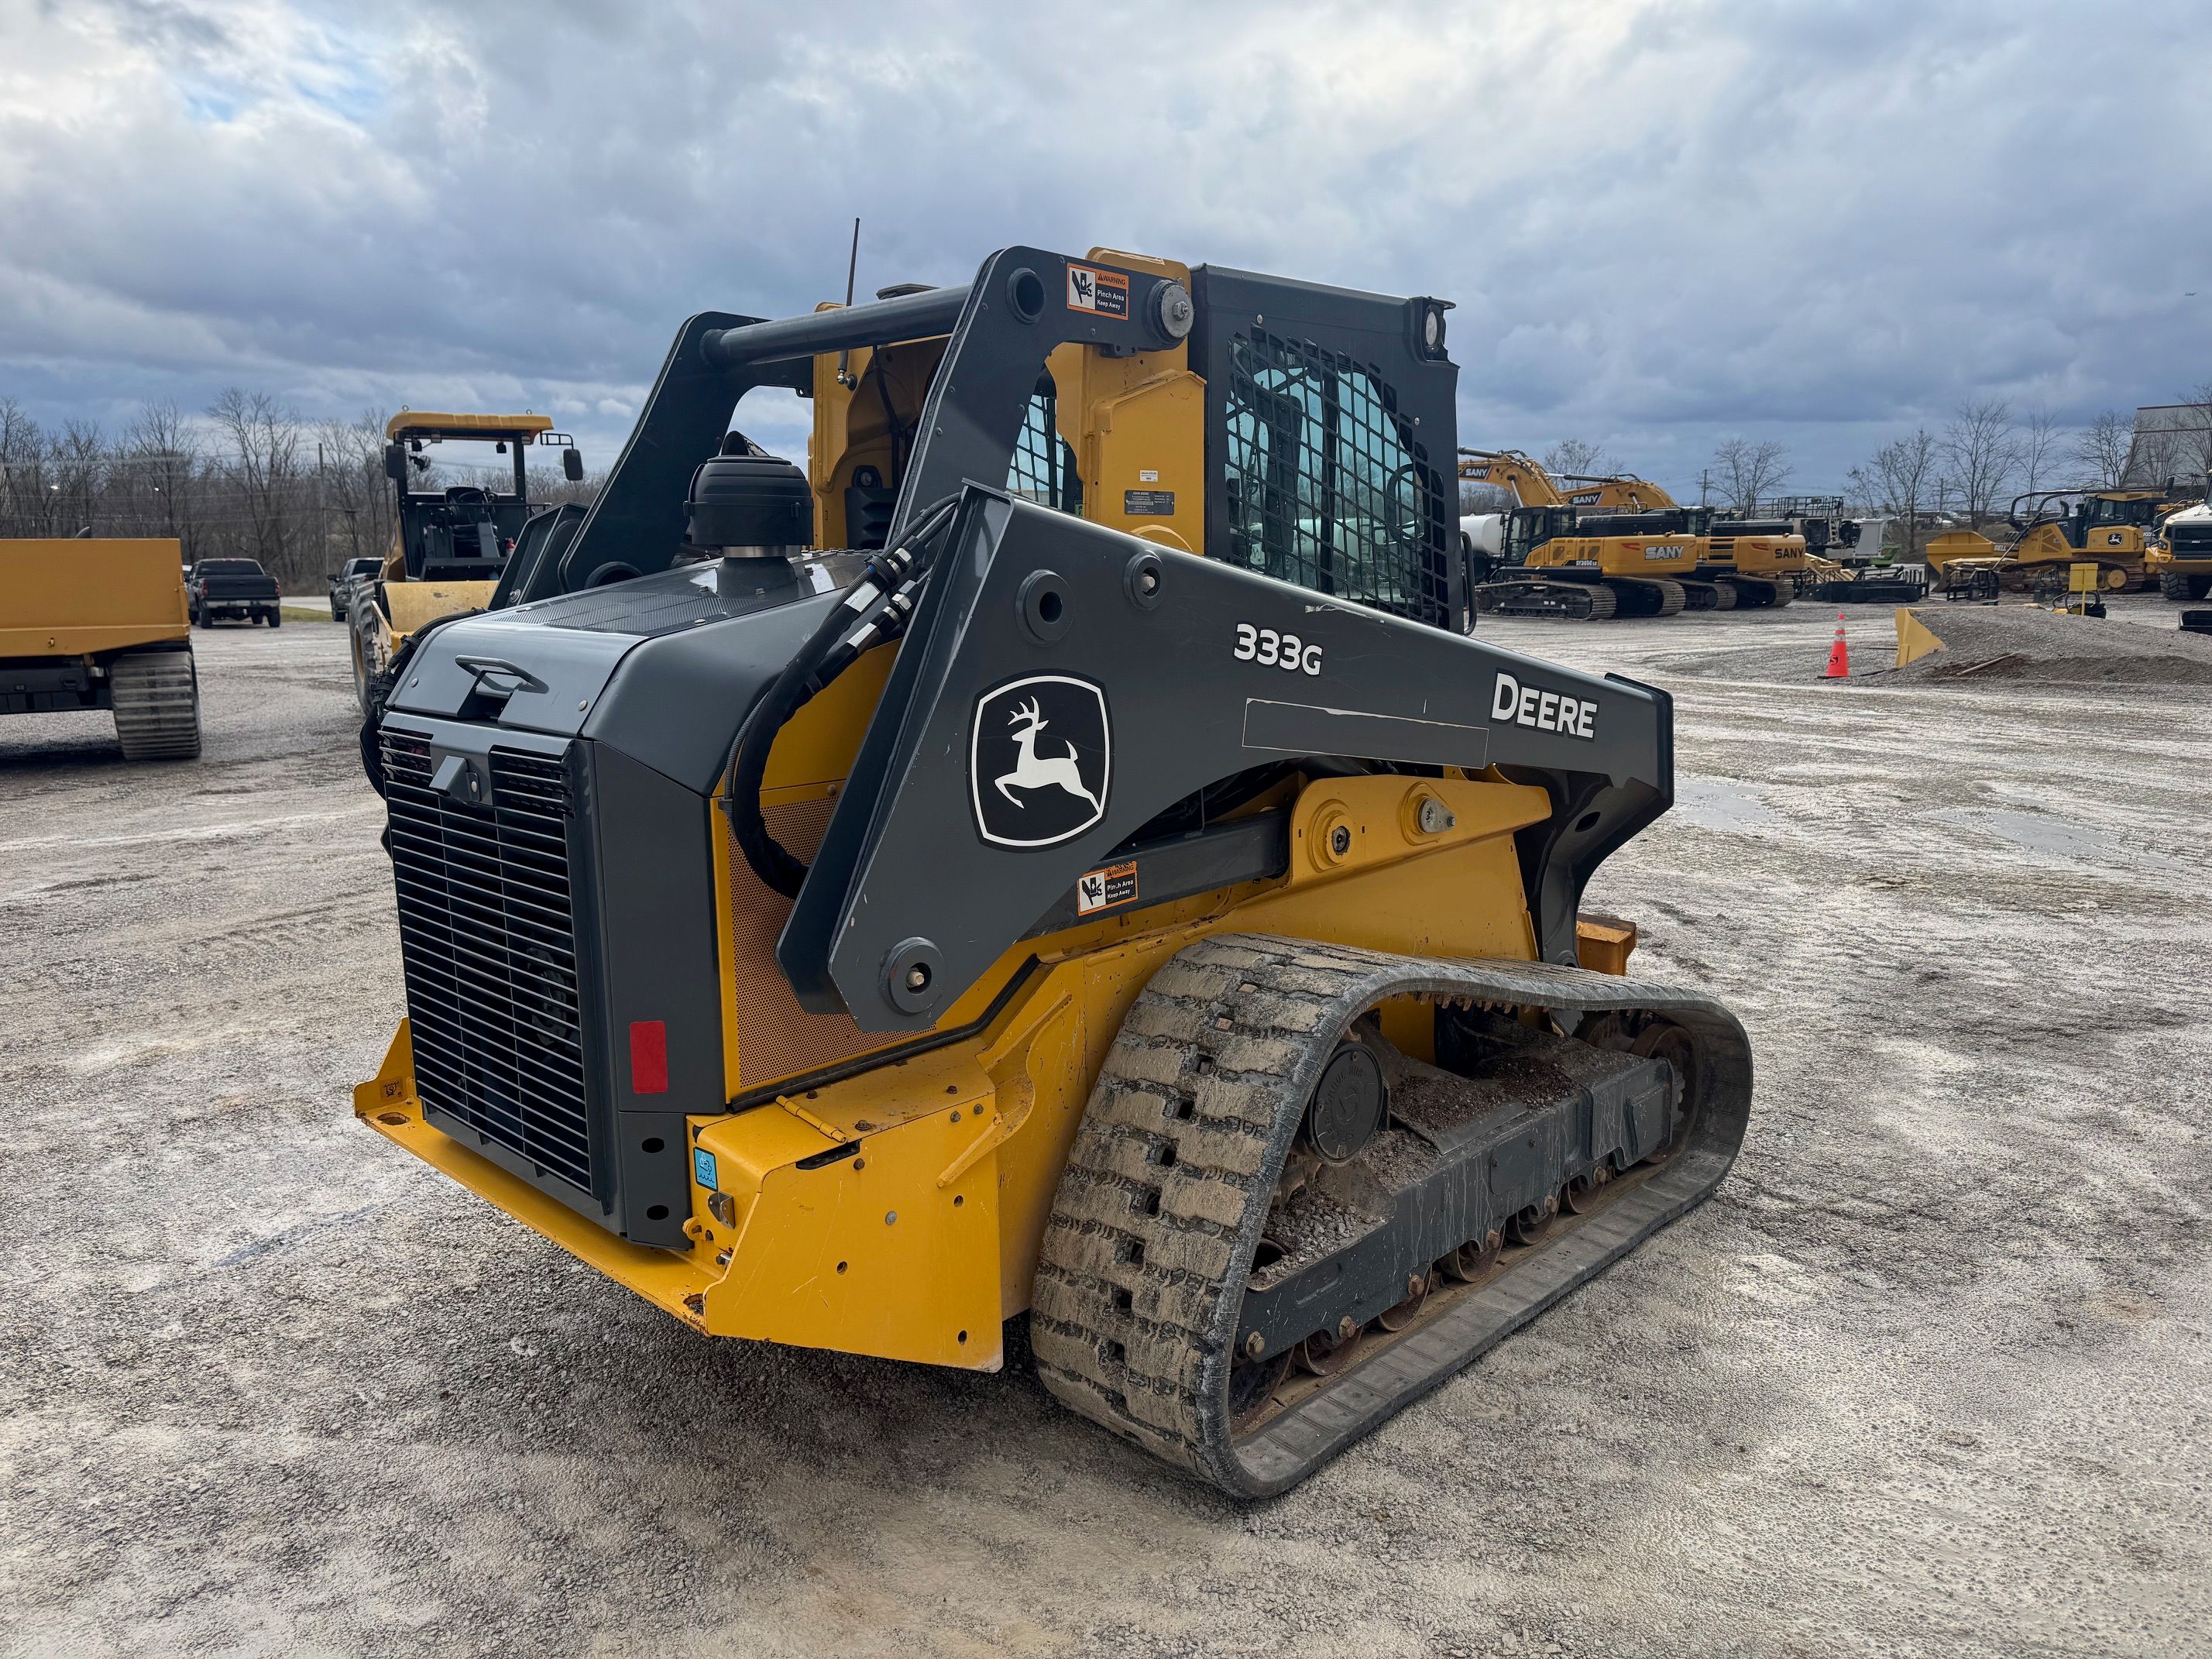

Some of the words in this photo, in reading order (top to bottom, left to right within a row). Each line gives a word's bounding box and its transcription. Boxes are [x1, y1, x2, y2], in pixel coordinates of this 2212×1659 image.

[1103, 275, 1125, 285] WARNING
[1097, 290, 1112, 299] Pinch
[1112, 293, 1125, 301] Area
[1097, 299, 1108, 307] Keep
[1108, 302, 1121, 311] Away
[1465, 467, 1488, 477] SANY
[1572, 495, 1599, 504] SANY
[1645, 545, 1685, 560] SANY
[1774, 548, 1804, 558] SANY
[1234, 623, 1323, 675] 333G
[1491, 672, 1598, 739] DEERE
